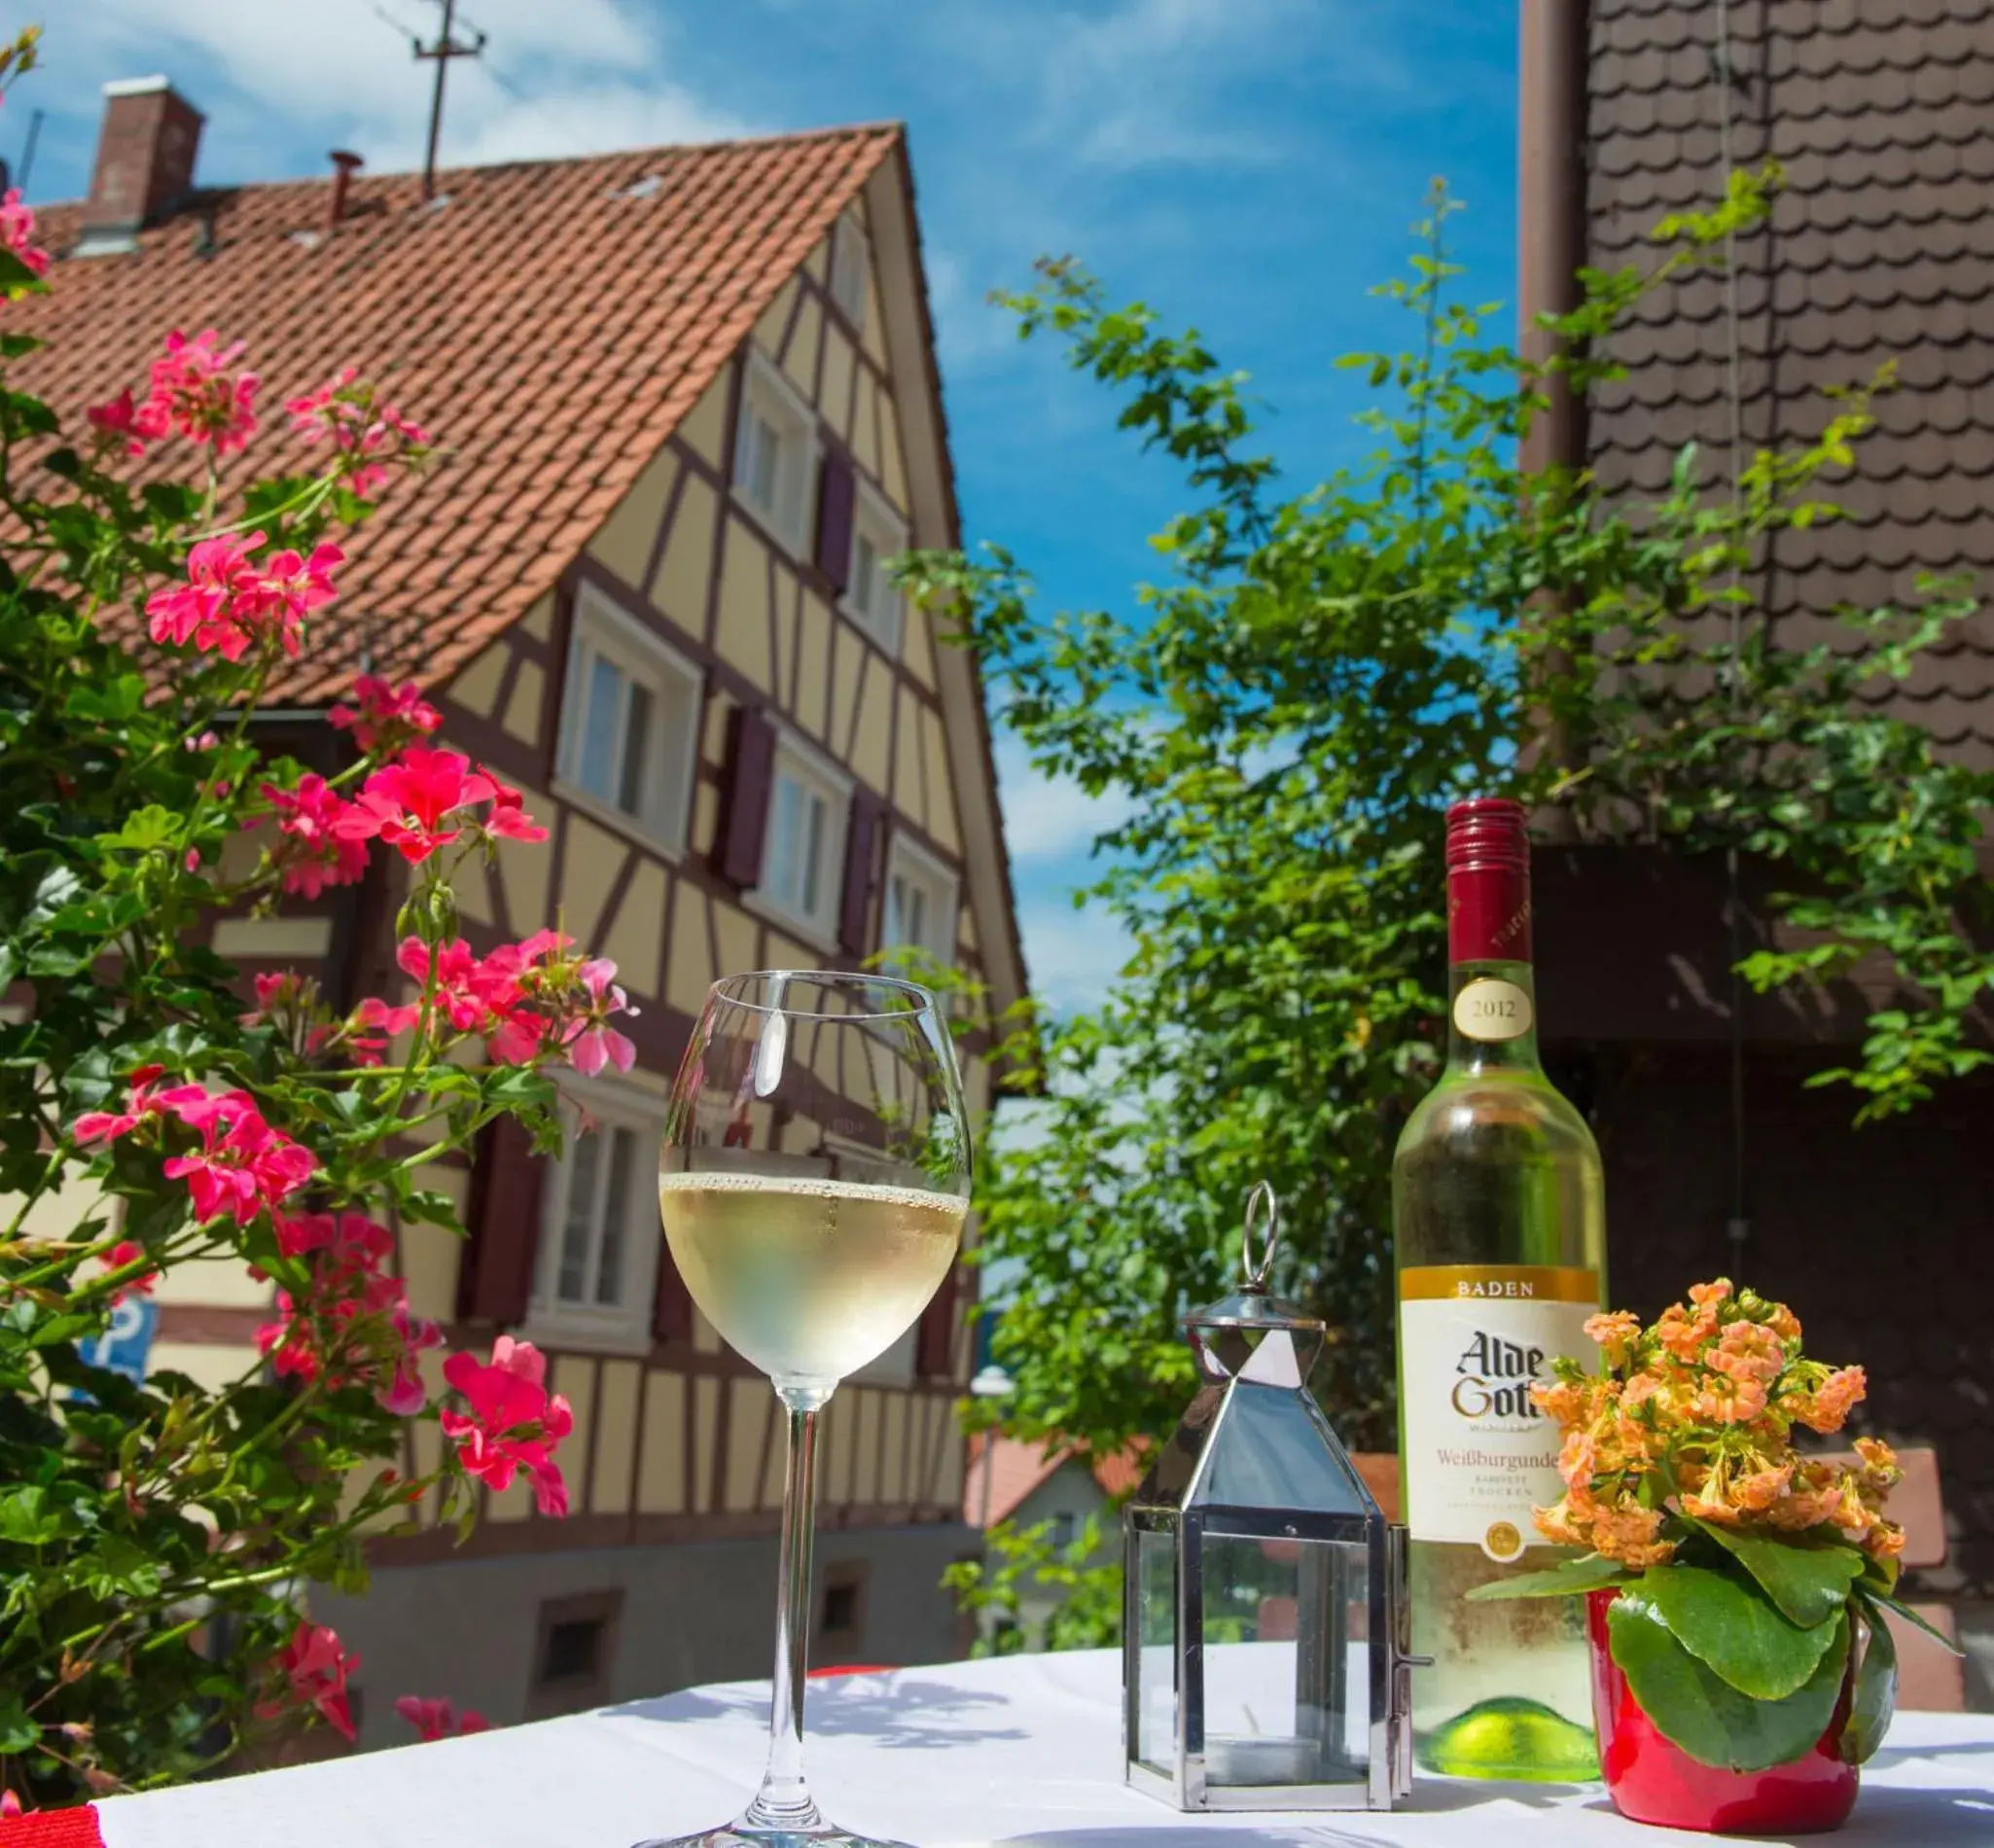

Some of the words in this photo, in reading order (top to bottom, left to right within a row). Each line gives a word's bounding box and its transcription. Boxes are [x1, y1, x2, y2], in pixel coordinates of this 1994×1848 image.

[1472, 1000, 1516, 1017] 2012
[1458, 1281, 1534, 1297] BADEN
[94, 1299, 143, 1366] P
[1455, 1331, 1545, 1377] Alde
[1437, 1449, 1558, 1472] Weißburgunde
